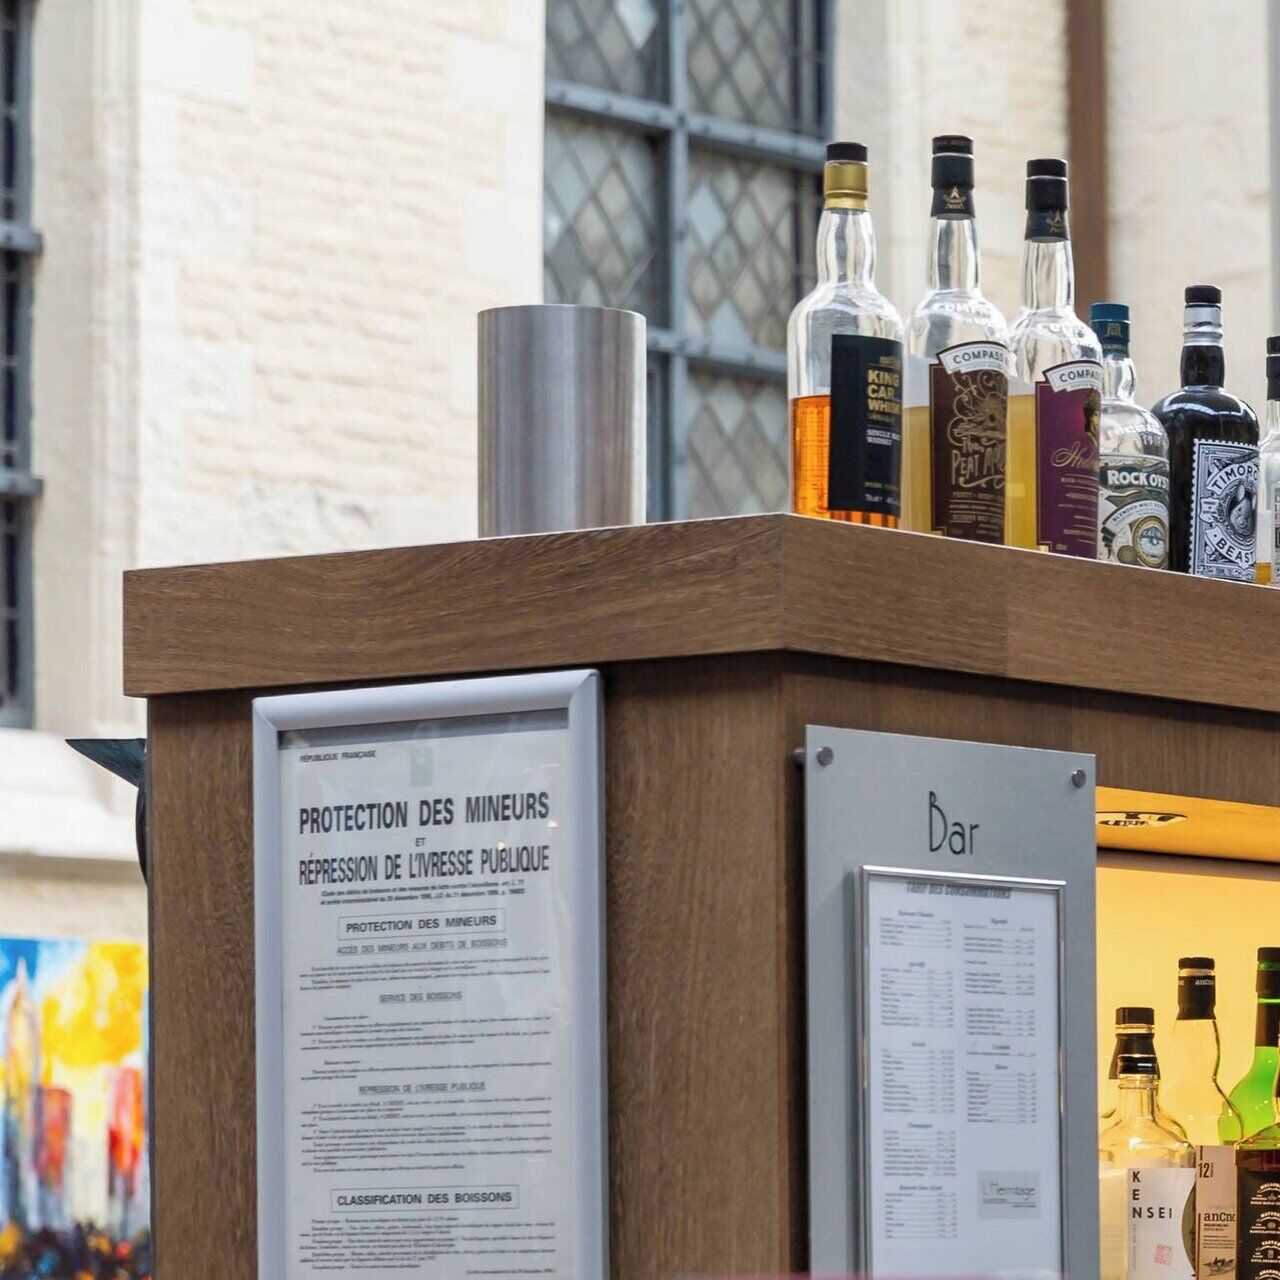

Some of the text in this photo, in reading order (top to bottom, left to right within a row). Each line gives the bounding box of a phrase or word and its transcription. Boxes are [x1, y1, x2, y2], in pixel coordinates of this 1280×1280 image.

[1107, 470, 1147, 485] ROCK
[300, 791, 550, 835] PROTECTION DES MINEURS
[929, 790, 980, 855] Bar
[415, 837, 426, 847] ET
[384, 854, 401, 880] DE
[409, 849, 473, 878] L'IVRESSE
[481, 845, 550, 875] PUBLIQUE
[346, 915, 497, 933] PROTECTION DES MINEURS
[337, 1191, 513, 1206] CLASSIFICATION DES BOISSONS
